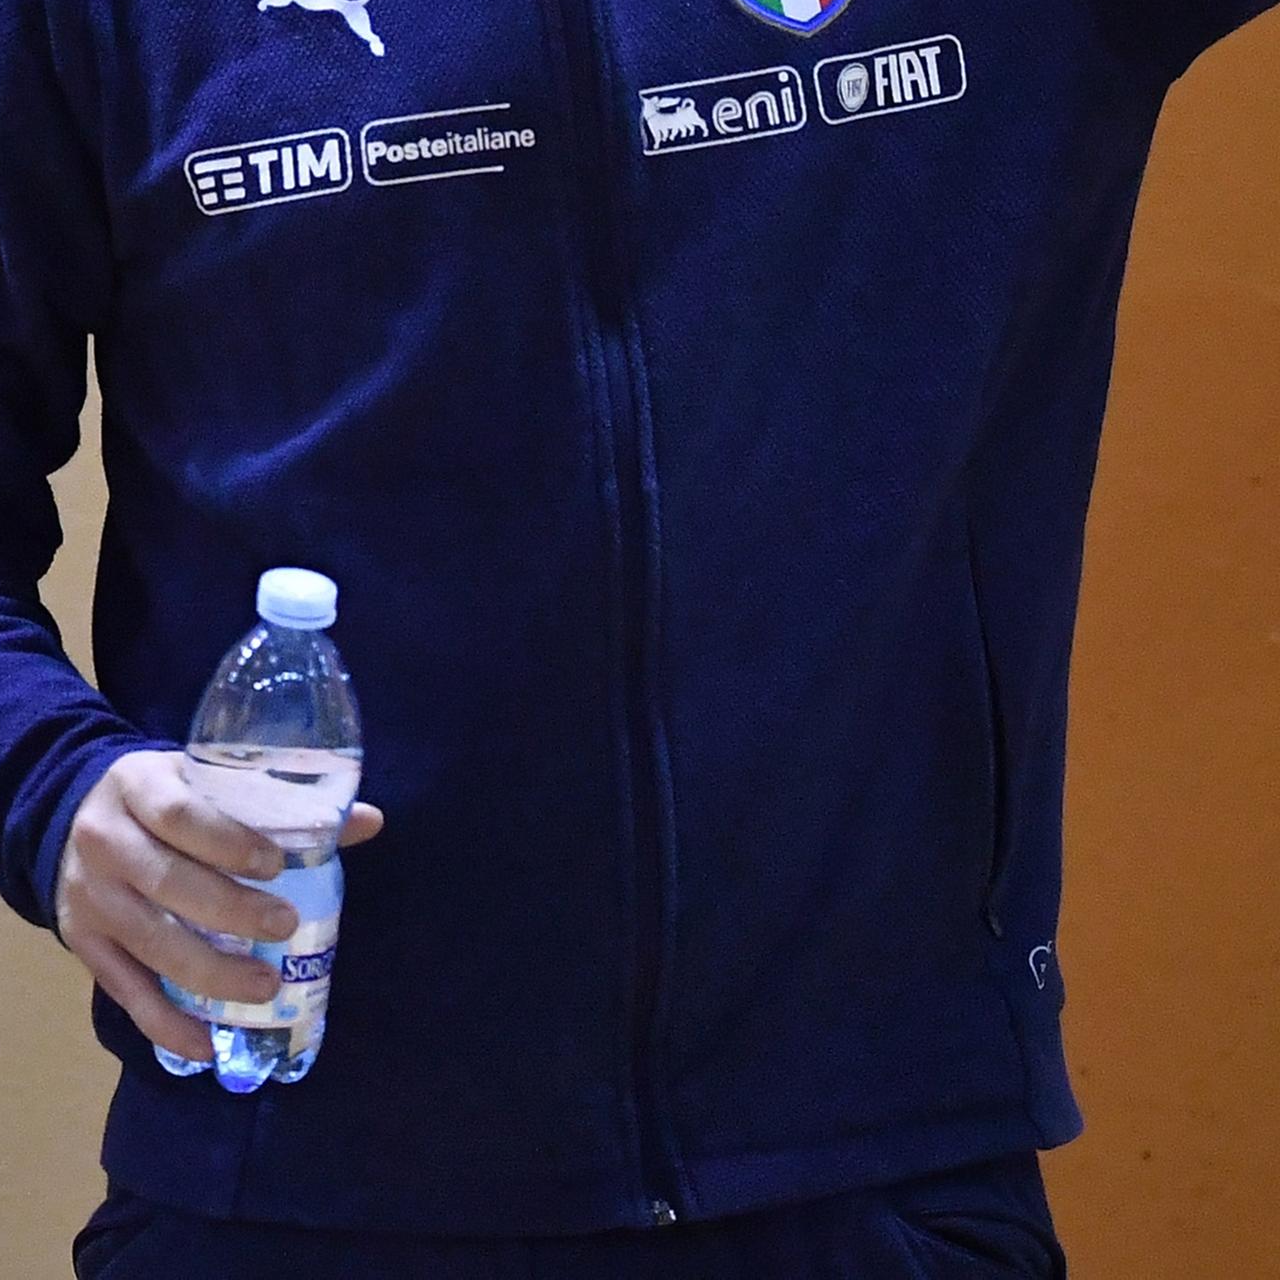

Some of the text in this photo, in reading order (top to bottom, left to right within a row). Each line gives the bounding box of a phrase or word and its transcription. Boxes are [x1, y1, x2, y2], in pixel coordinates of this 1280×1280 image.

[712, 71, 796, 134] eni
[874, 46, 941, 106] FIAT
[248, 139, 342, 195] TIM
[367, 125, 535, 166] Posteitaliane
